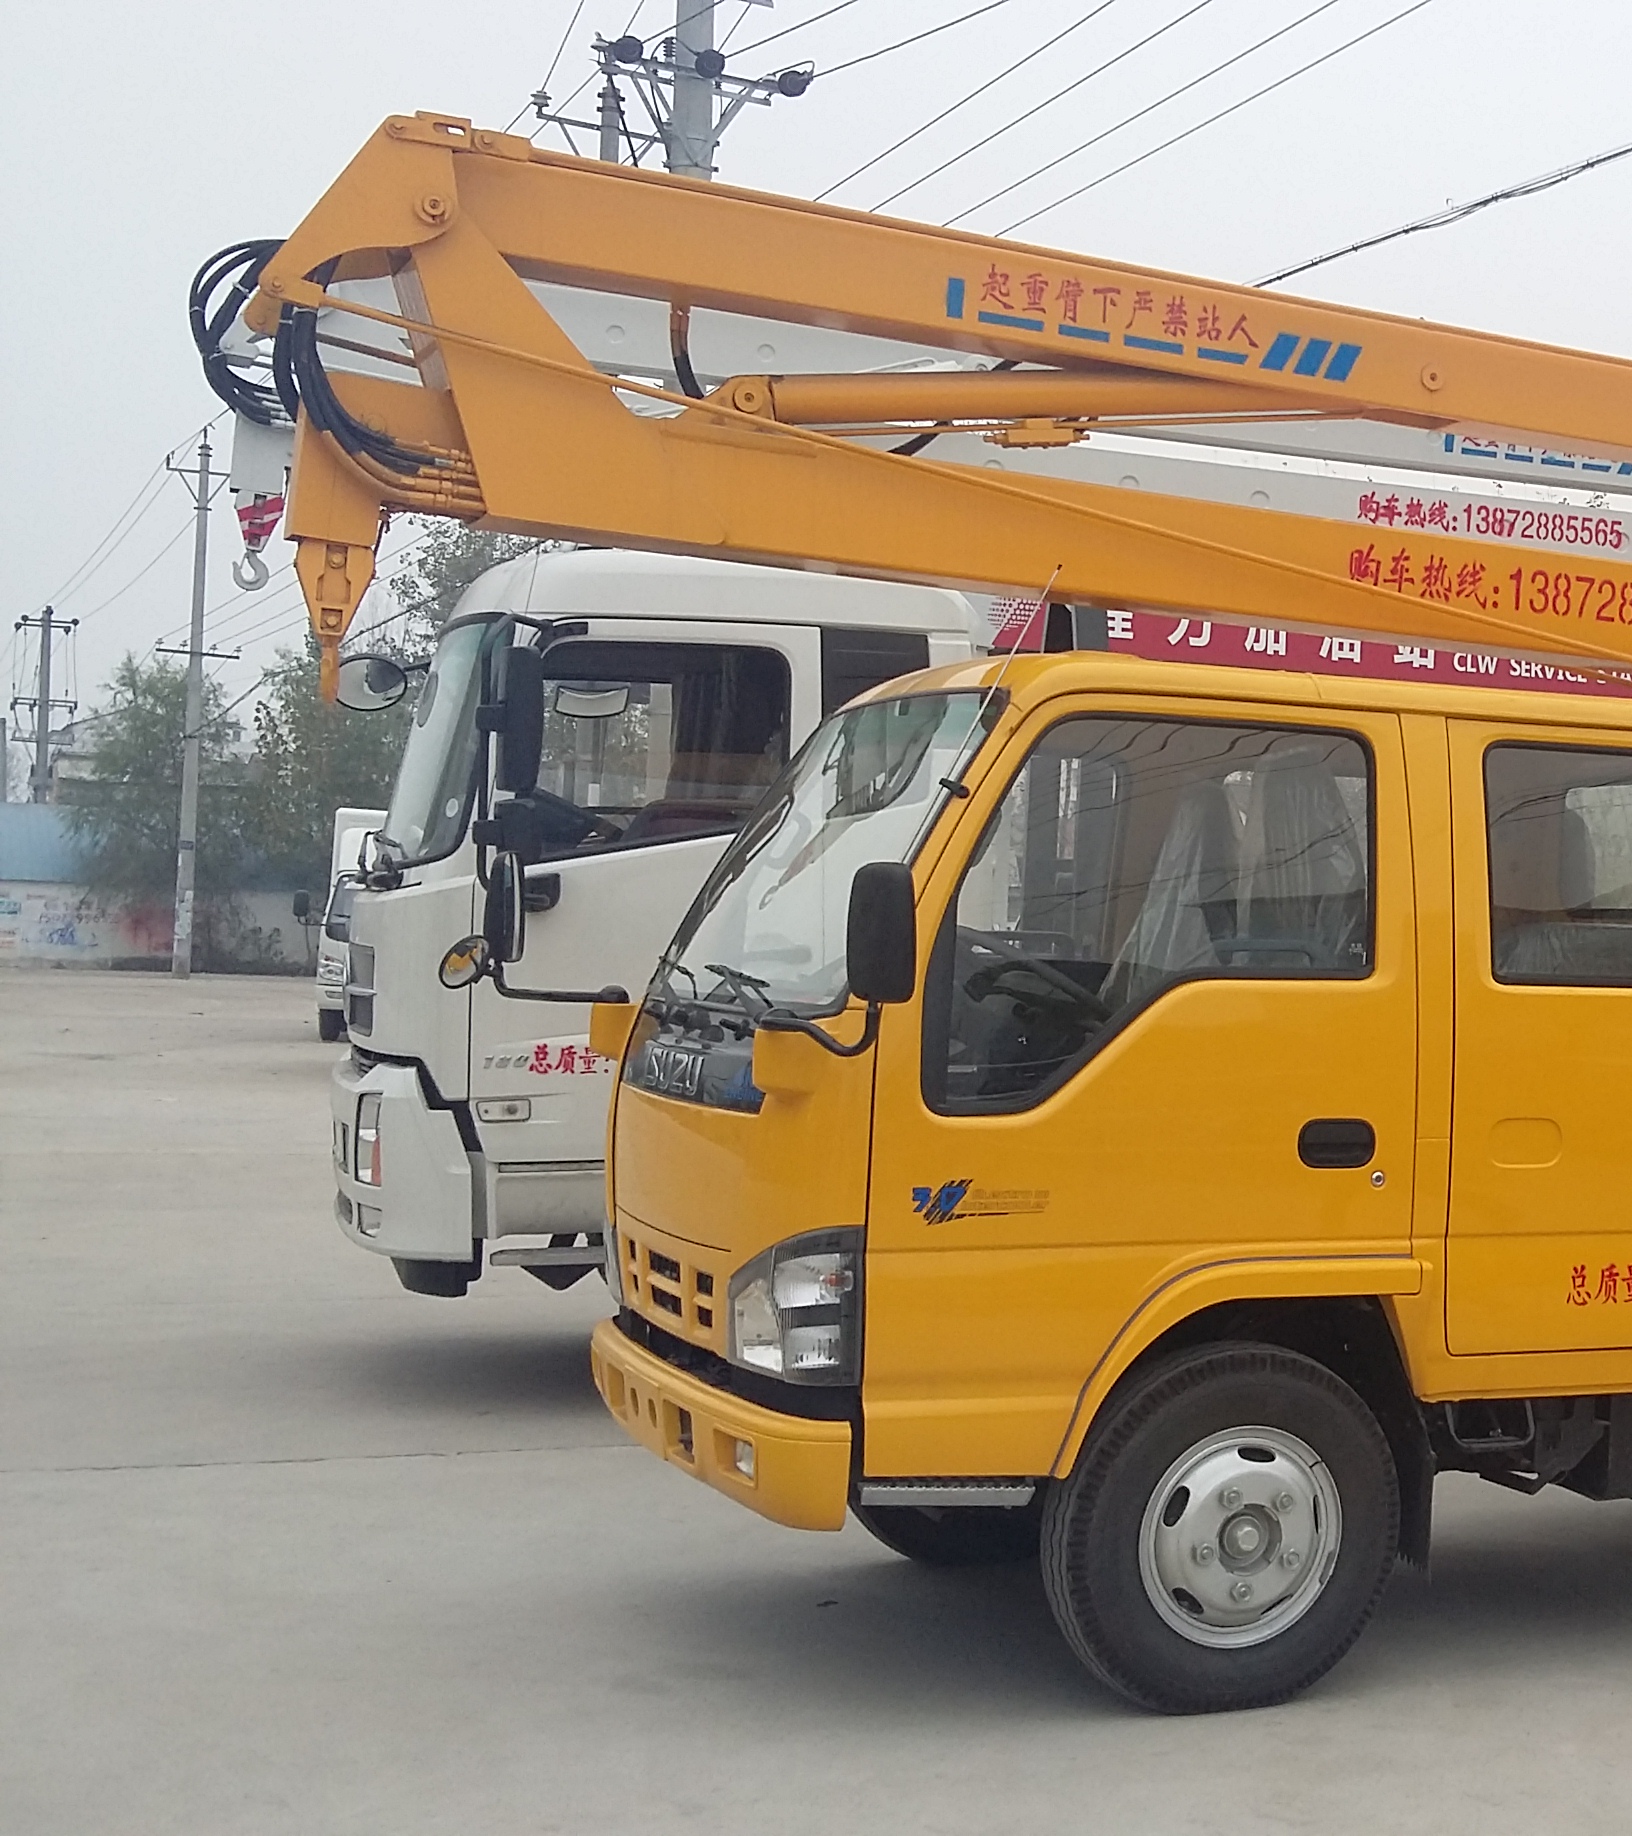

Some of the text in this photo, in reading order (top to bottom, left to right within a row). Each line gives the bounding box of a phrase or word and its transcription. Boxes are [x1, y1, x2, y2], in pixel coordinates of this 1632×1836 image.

[980, 265, 1259, 350] 起重臂下严禁站人
[1453, 652, 1498, 675] CLW
